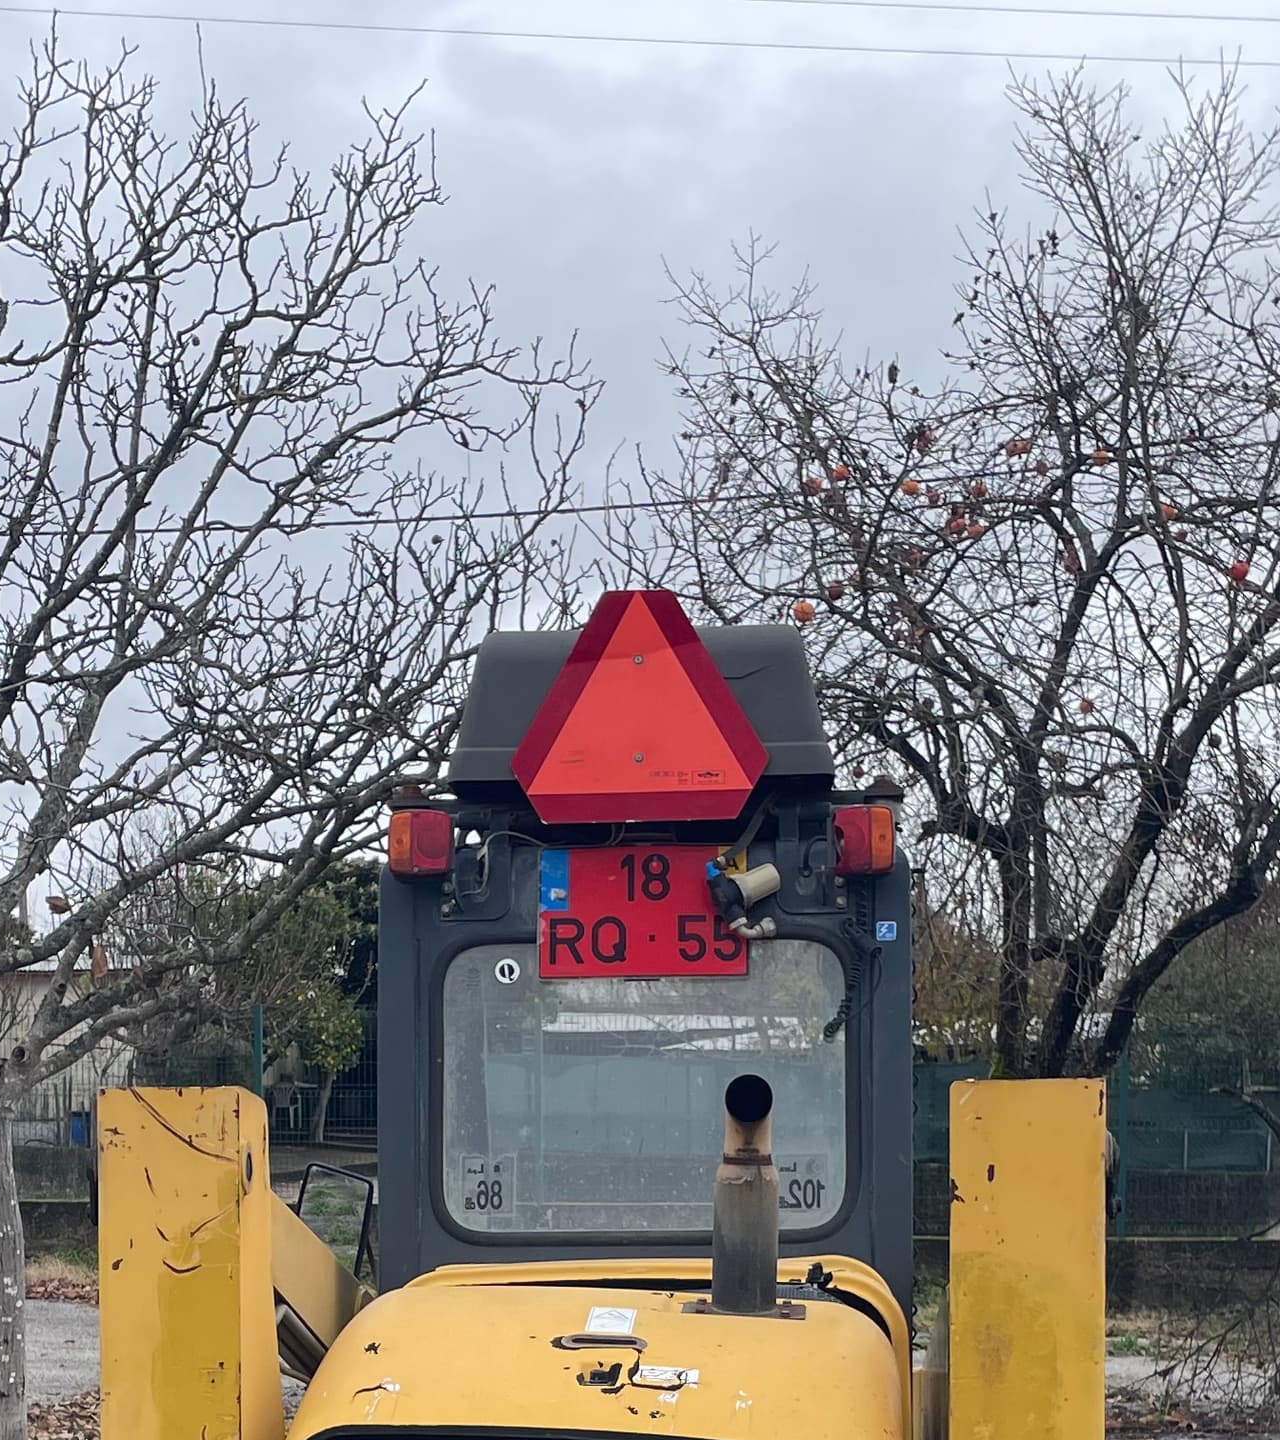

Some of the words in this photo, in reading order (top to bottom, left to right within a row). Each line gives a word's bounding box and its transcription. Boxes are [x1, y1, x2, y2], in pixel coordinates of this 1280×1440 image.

[620, 854, 670, 901] 18
[549, 916, 626, 964] RQ
[677, 915, 743, 962] 55
